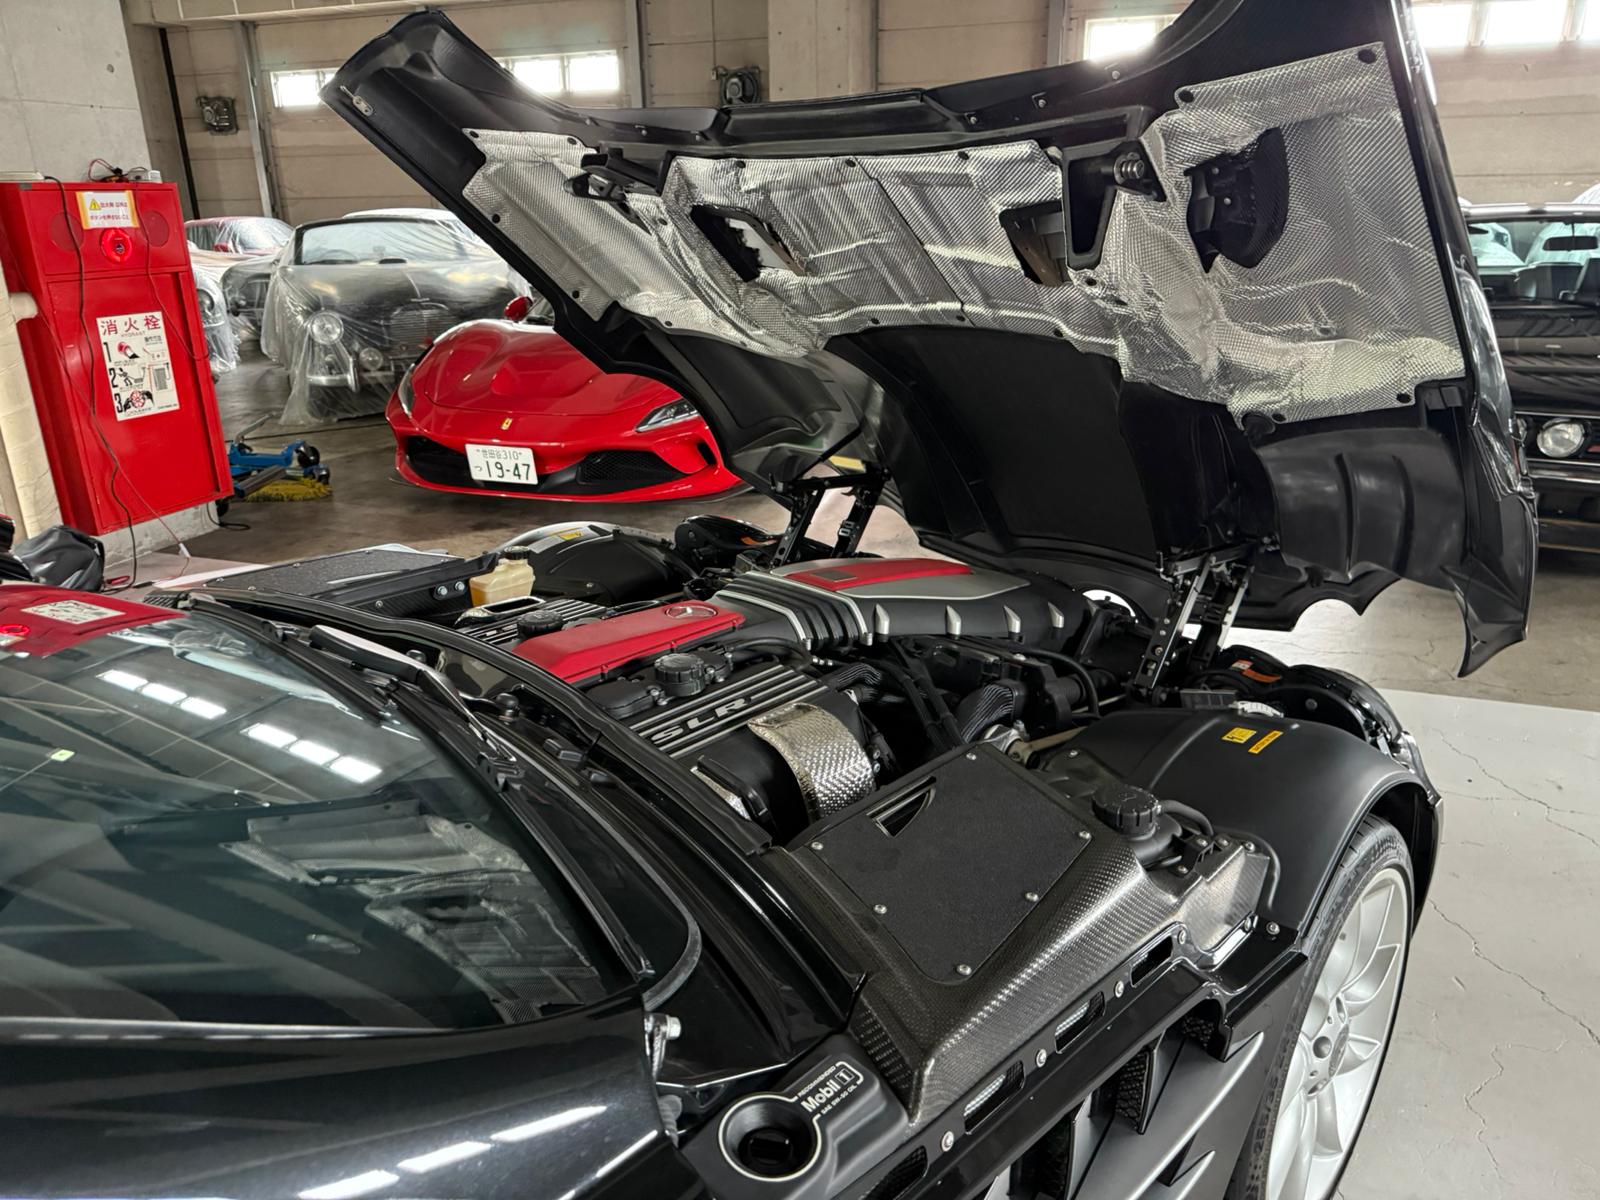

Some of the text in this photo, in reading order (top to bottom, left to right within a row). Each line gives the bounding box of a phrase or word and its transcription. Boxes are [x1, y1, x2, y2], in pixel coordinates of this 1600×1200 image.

[100, 314, 161, 336] 消火栓
[103, 341, 112, 362] 1
[109, 367, 118, 388] 2
[114, 393, 123, 413] 3
[486, 460, 531, 481] 19-47
[651, 698, 748, 745] SLR
[801, 1079, 841, 1112] Mobil
